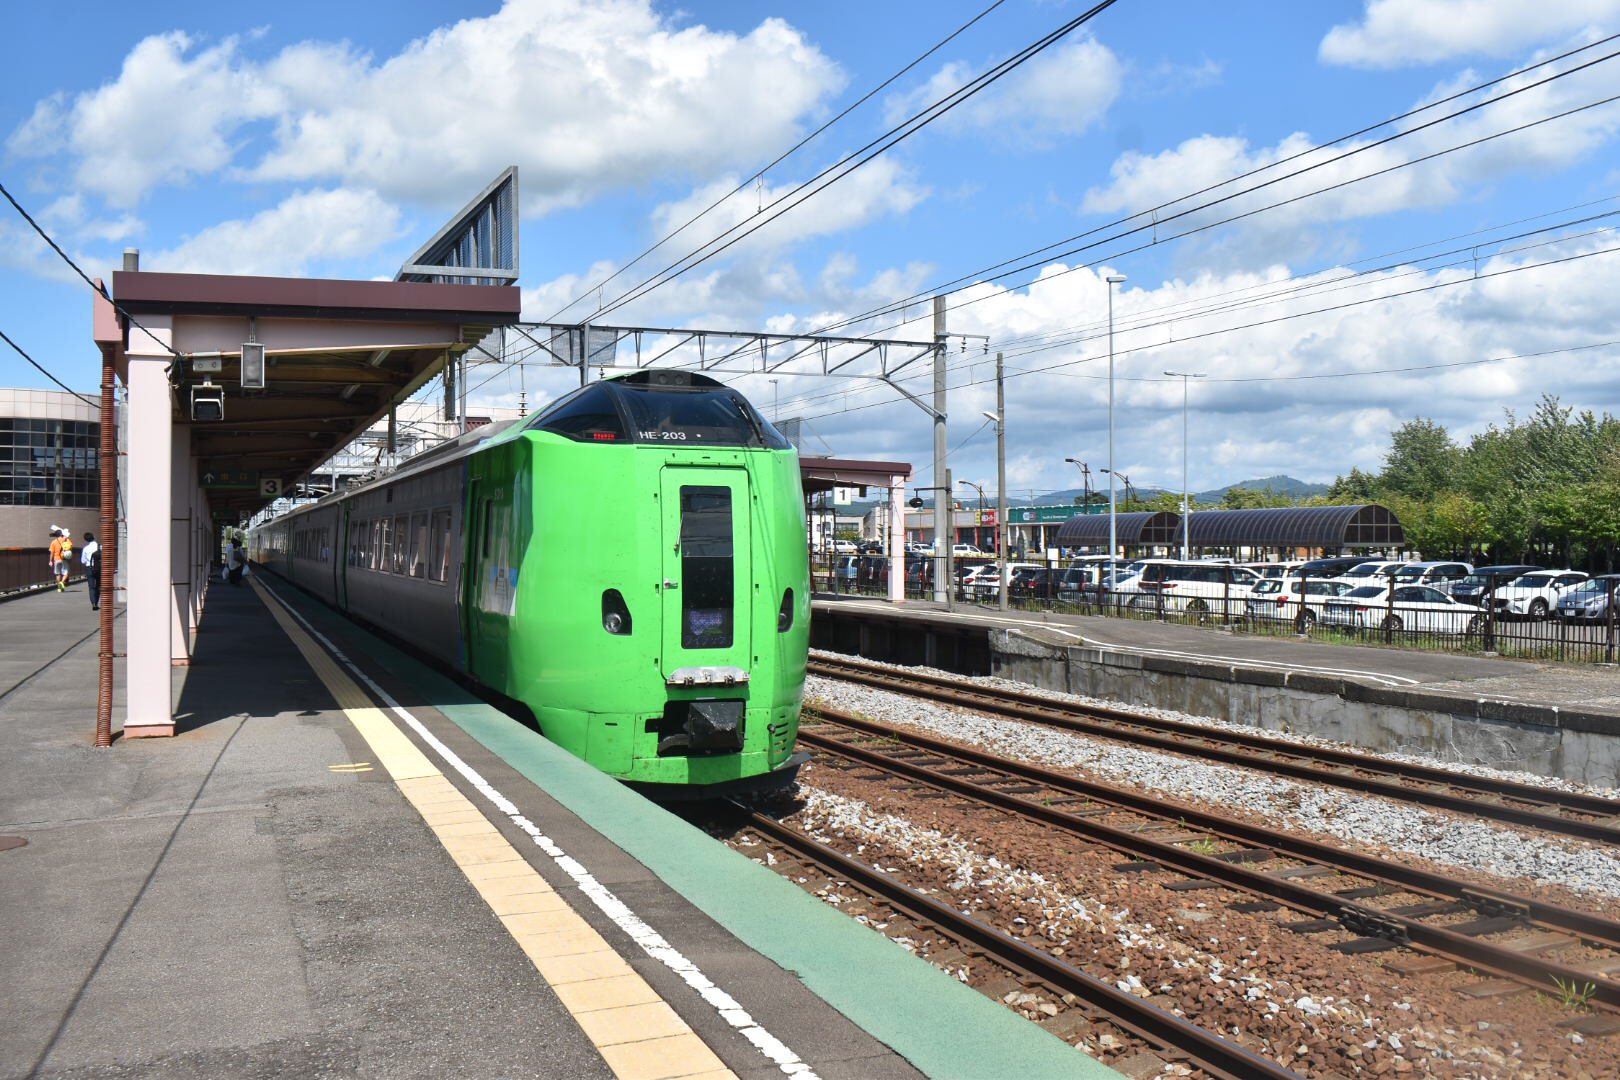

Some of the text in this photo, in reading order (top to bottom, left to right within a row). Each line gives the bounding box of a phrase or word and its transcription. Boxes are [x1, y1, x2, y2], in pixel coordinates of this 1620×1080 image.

[639, 431, 686, 440] HE-203
[265, 480, 277, 494] 3
[839, 489, 846, 501] 1
